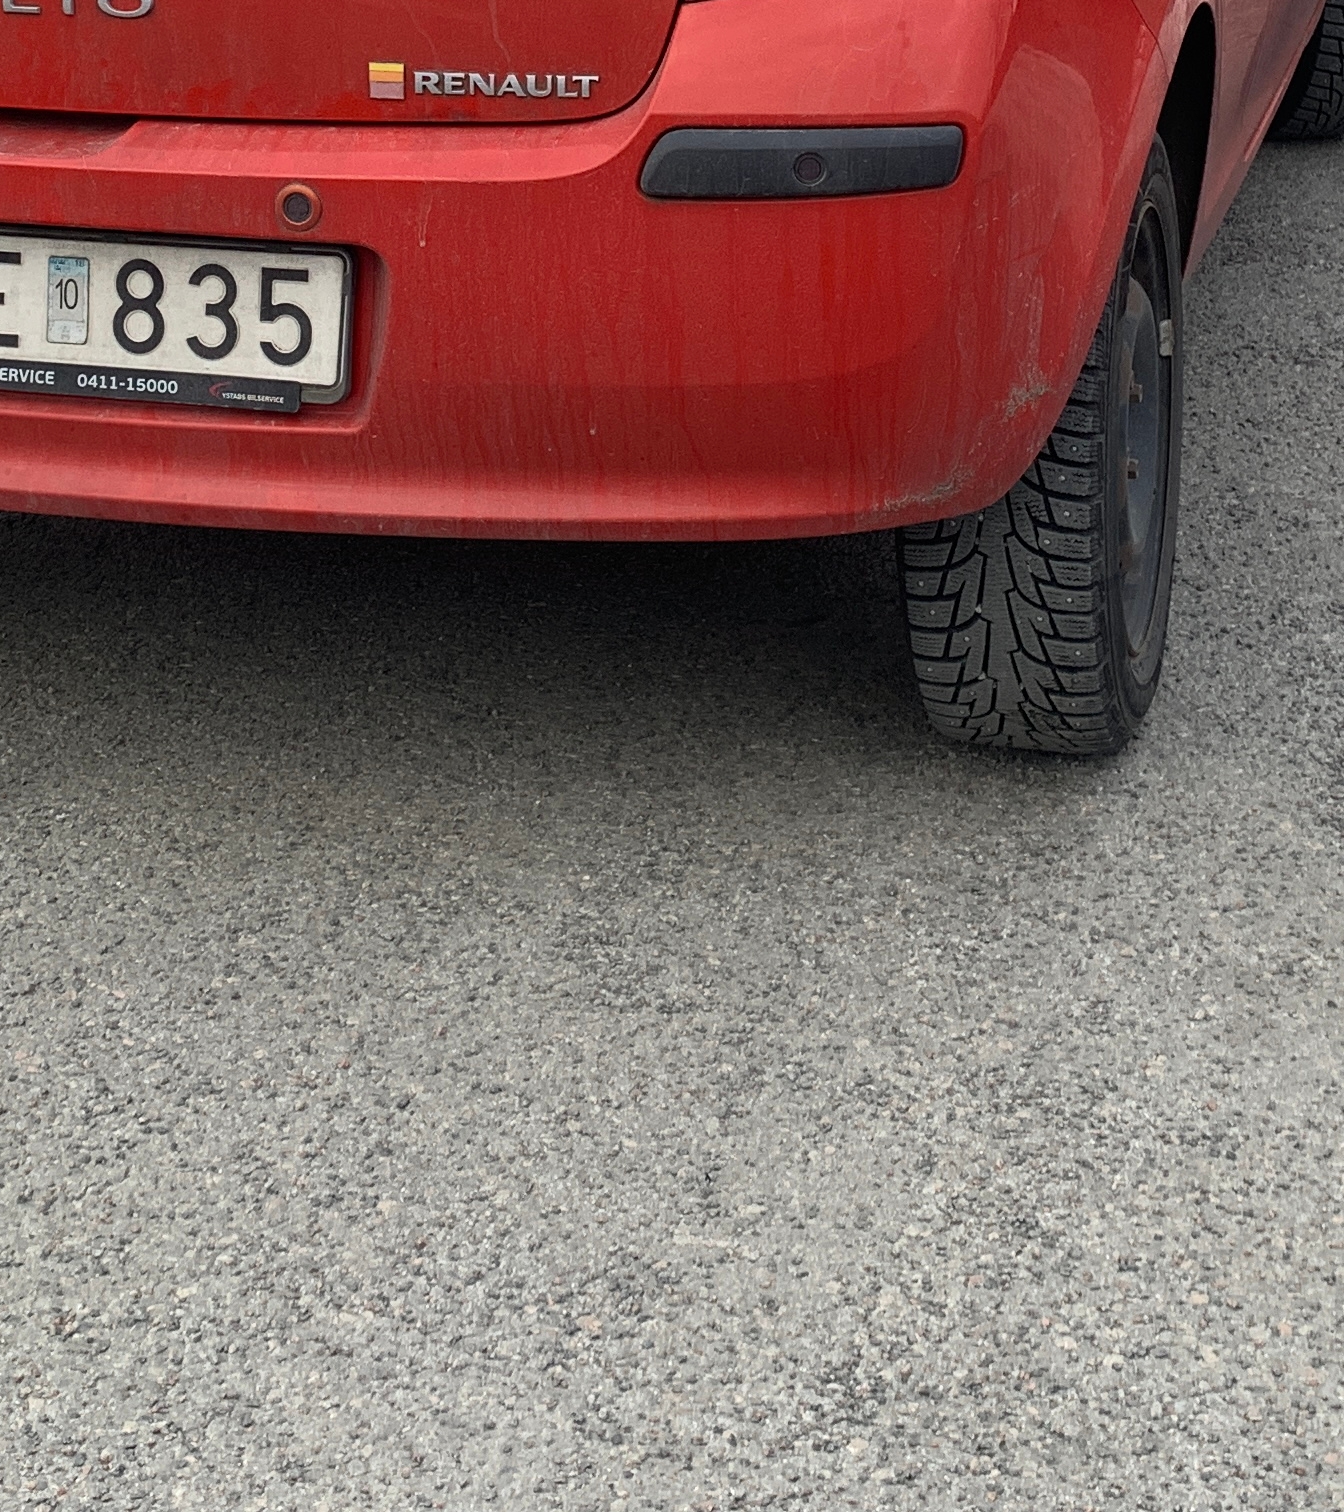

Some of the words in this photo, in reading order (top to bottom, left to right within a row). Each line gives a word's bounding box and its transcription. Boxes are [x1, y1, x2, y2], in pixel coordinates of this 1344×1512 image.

[413, 71, 600, 99] RENAULT
[55, 278, 78, 310] 10
[112, 258, 313, 367] 835
[77, 373, 178, 394] 0411-15000
[221, 391, 246, 401] YSTADS
[247, 393, 285, 404] BILSERVICE
